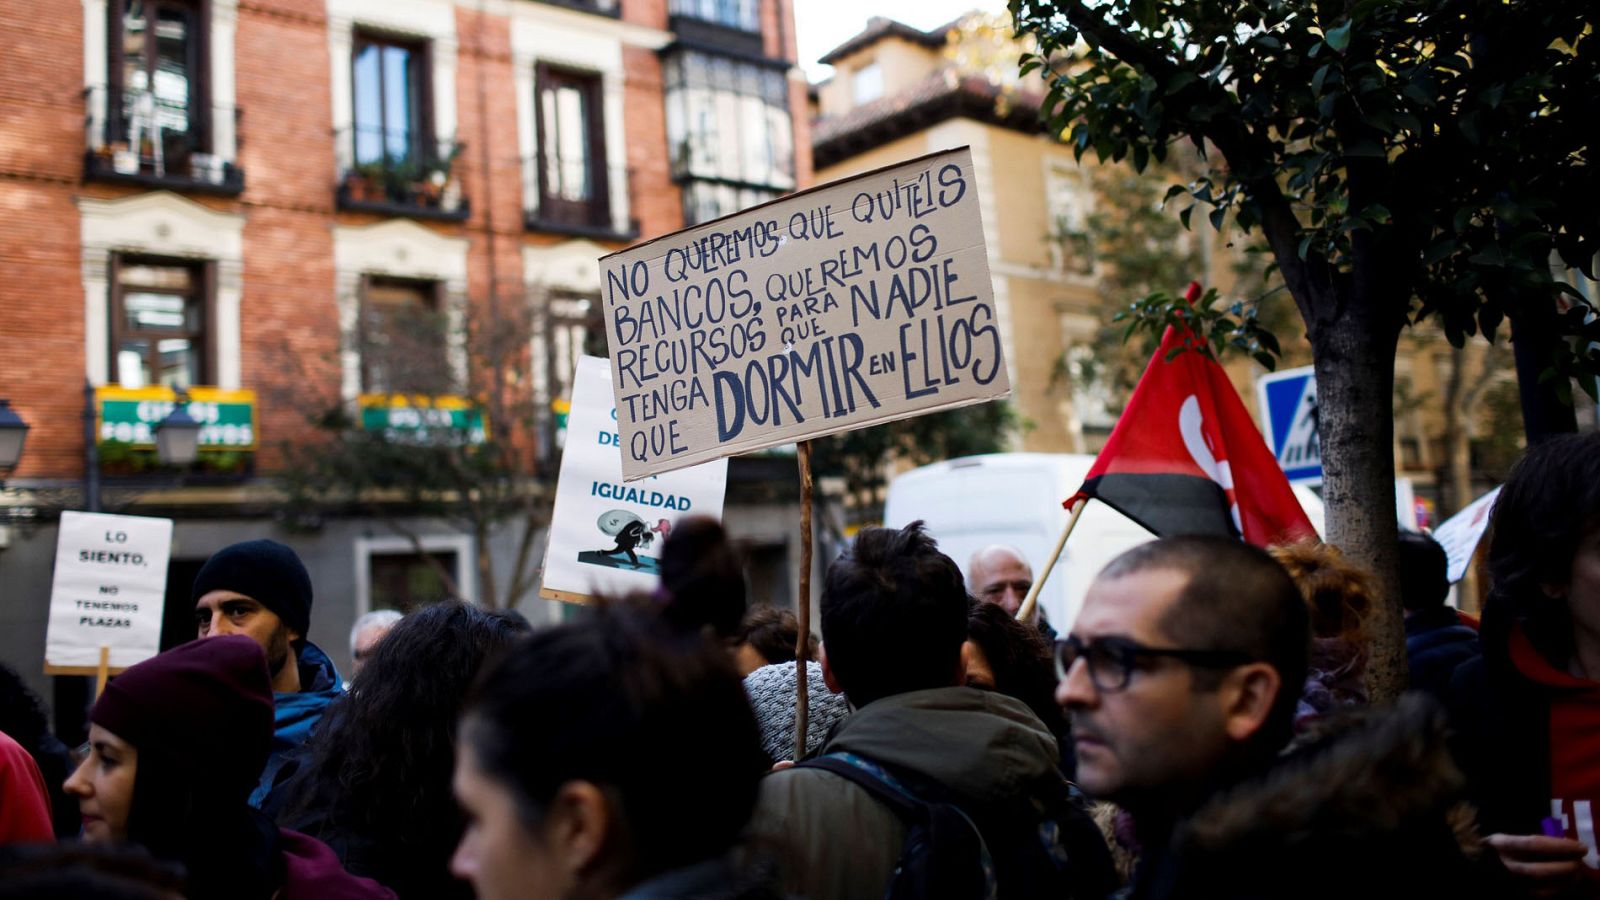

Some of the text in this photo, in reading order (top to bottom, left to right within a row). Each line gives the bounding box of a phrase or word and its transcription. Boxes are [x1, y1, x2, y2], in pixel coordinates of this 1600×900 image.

[607, 164, 966, 305] NO QUEREMOS QUE QUITÉIS
[614, 224, 937, 346] BANCOS, QUEREMOS
[616, 258, 977, 389] RECURSOS PARA QUE NADIE
[622, 303, 1001, 463] TENGA QUE DORMIR EN ELLOS
[591, 481, 692, 512] IGUALDAD
[105, 531, 127, 543] LO
[79, 550, 148, 567] SIENTO,
[99, 585, 119, 596] NO
[75, 600, 139, 612] TENEMOS
[79, 617, 132, 628] PLAZAS
